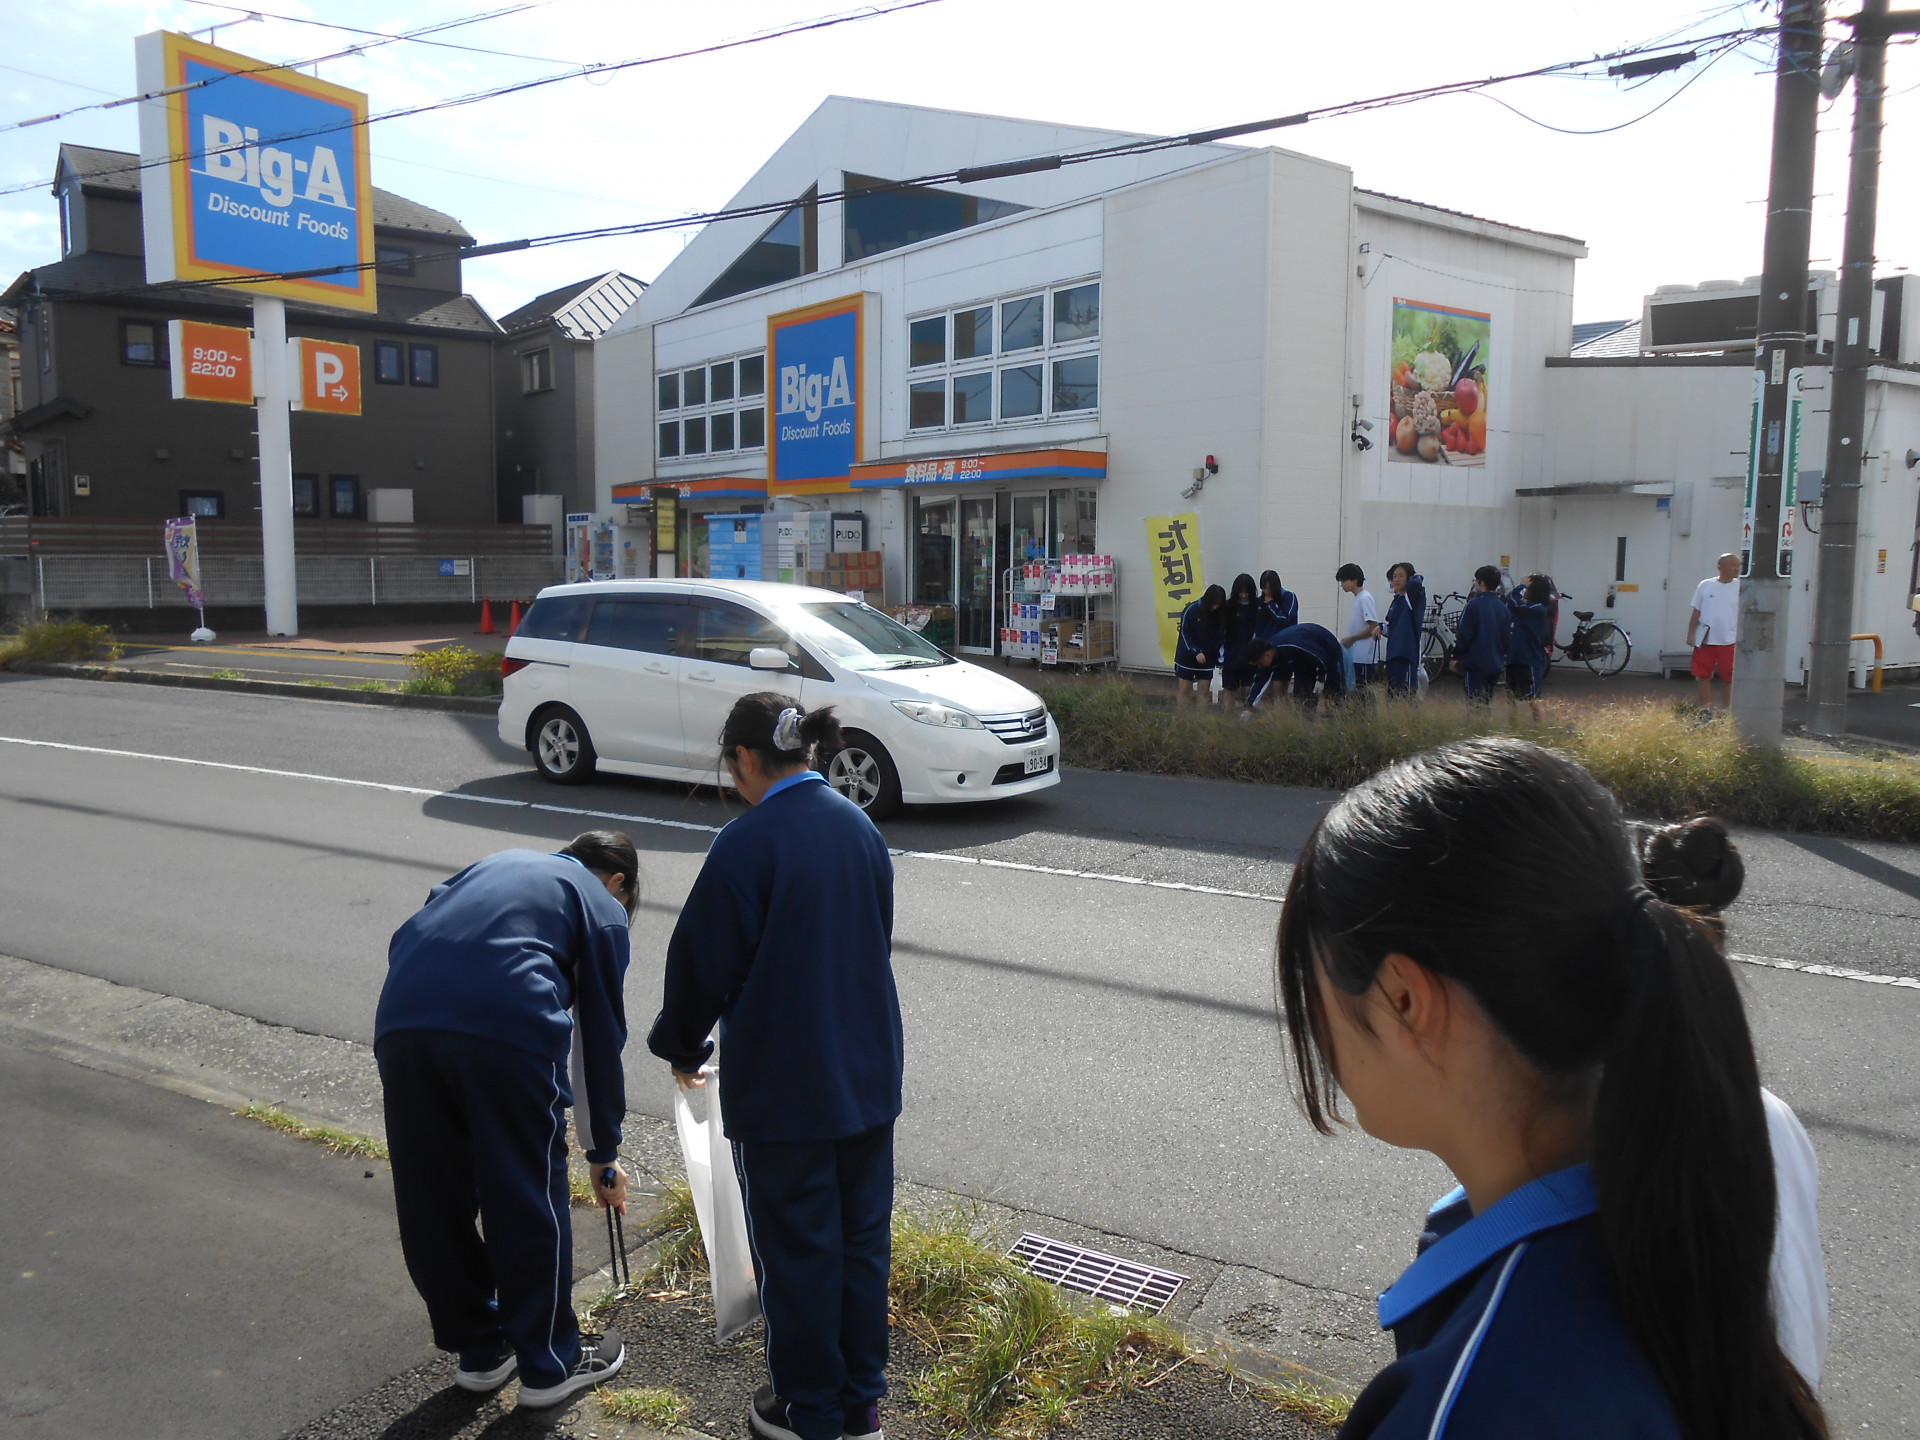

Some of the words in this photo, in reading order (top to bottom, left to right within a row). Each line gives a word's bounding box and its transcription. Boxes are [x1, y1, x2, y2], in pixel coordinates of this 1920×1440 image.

[203, 114, 348, 208] Big-A
[208, 192, 290, 227] Discount
[297, 212, 349, 240] Foods
[191, 362, 236, 378] 22:00
[315, 351, 344, 398] P
[781, 356, 851, 422] Big-A
[781, 424, 820, 441] Discount
[822, 419, 851, 437] Foods
[904, 461, 956, 483] 食料品・酒
[960, 469, 982, 480] 22:00
[835, 530, 861, 540] PUDO
